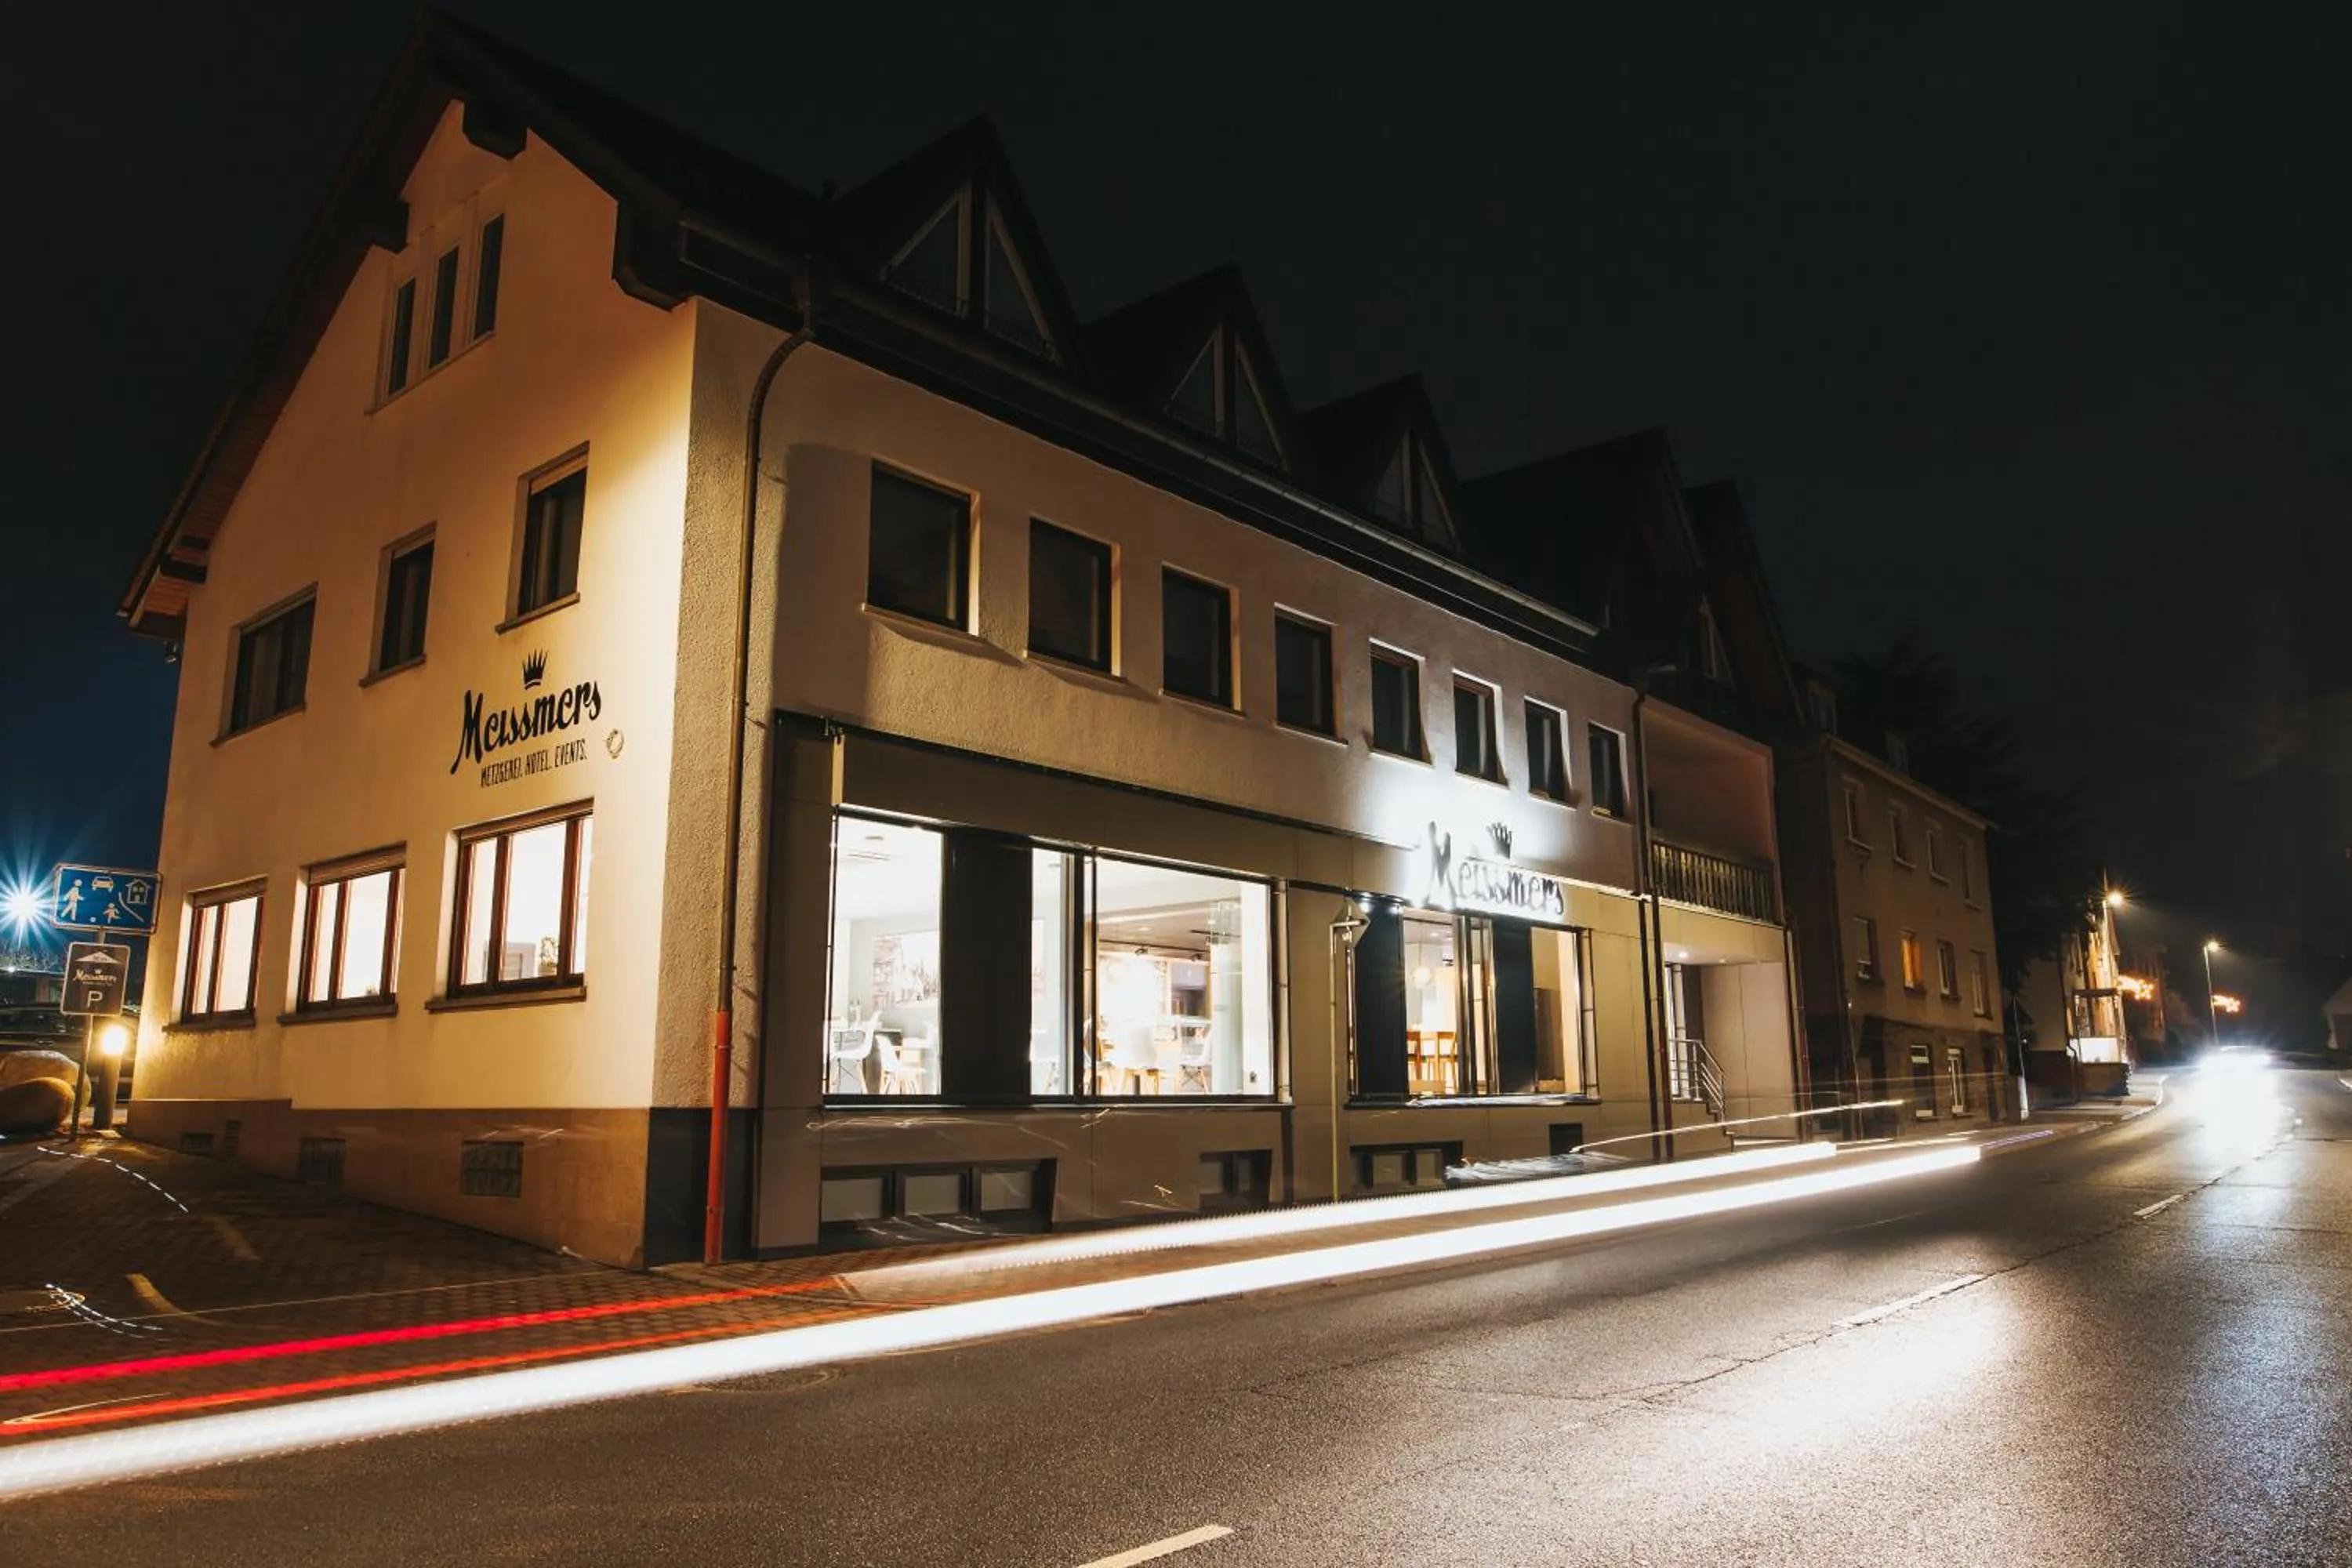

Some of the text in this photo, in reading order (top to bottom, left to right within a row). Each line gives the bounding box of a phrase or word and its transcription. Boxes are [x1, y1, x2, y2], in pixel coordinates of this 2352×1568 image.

[450, 681, 601, 775] Meissmers
[524, 749, 552, 775] HOTEL.
[554, 738, 587, 768] EVENTS.
[1422, 821, 1564, 916] Meissmers
[87, 990, 103, 1007] P
